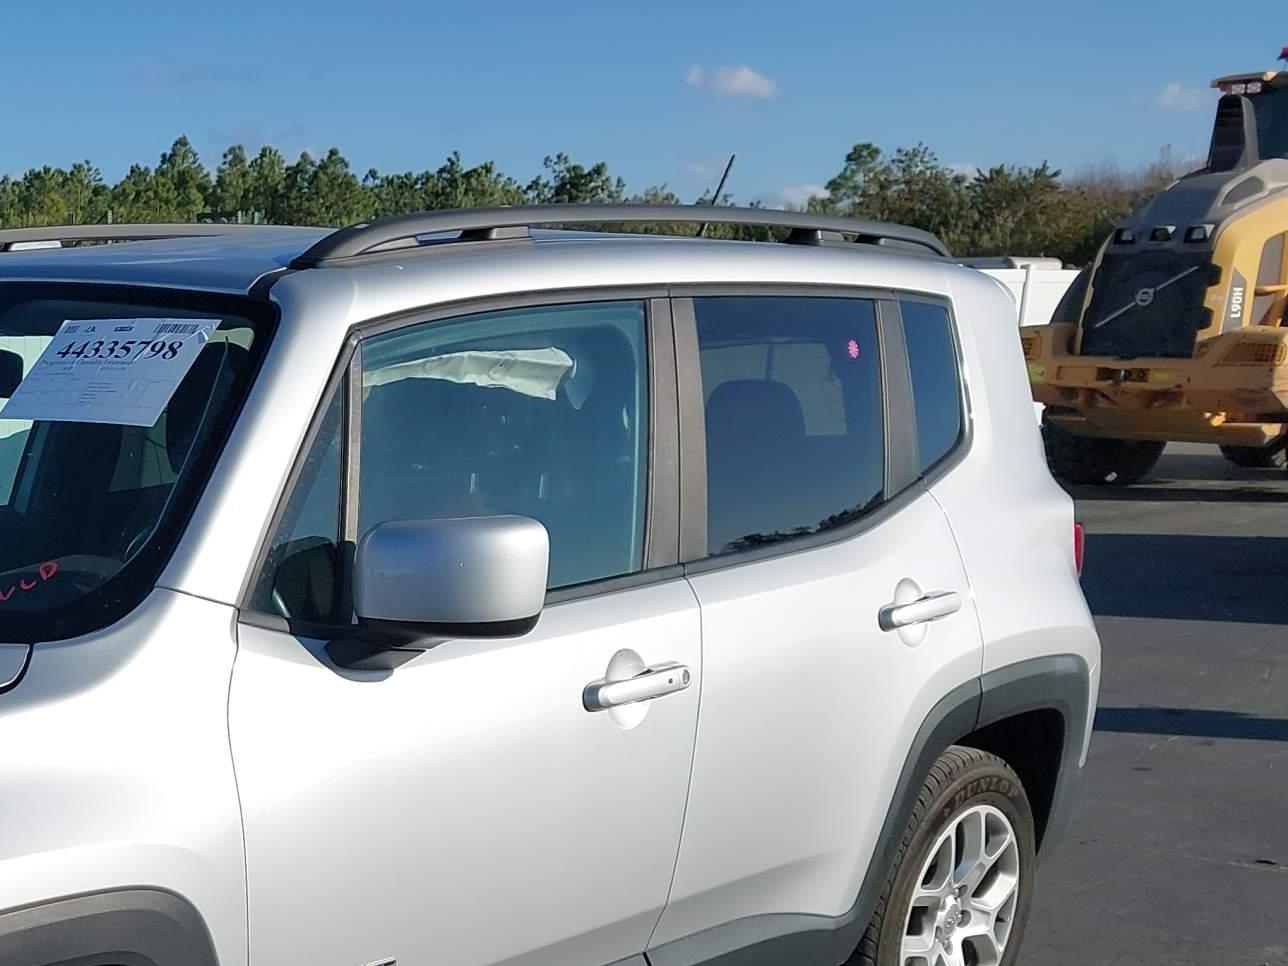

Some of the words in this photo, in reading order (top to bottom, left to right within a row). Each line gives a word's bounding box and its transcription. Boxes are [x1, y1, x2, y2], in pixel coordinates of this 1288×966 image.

[1230, 287, 1244, 318] L90H
[56, 340, 183, 361] 44335798
[954, 776, 1019, 808] DUNLOP
